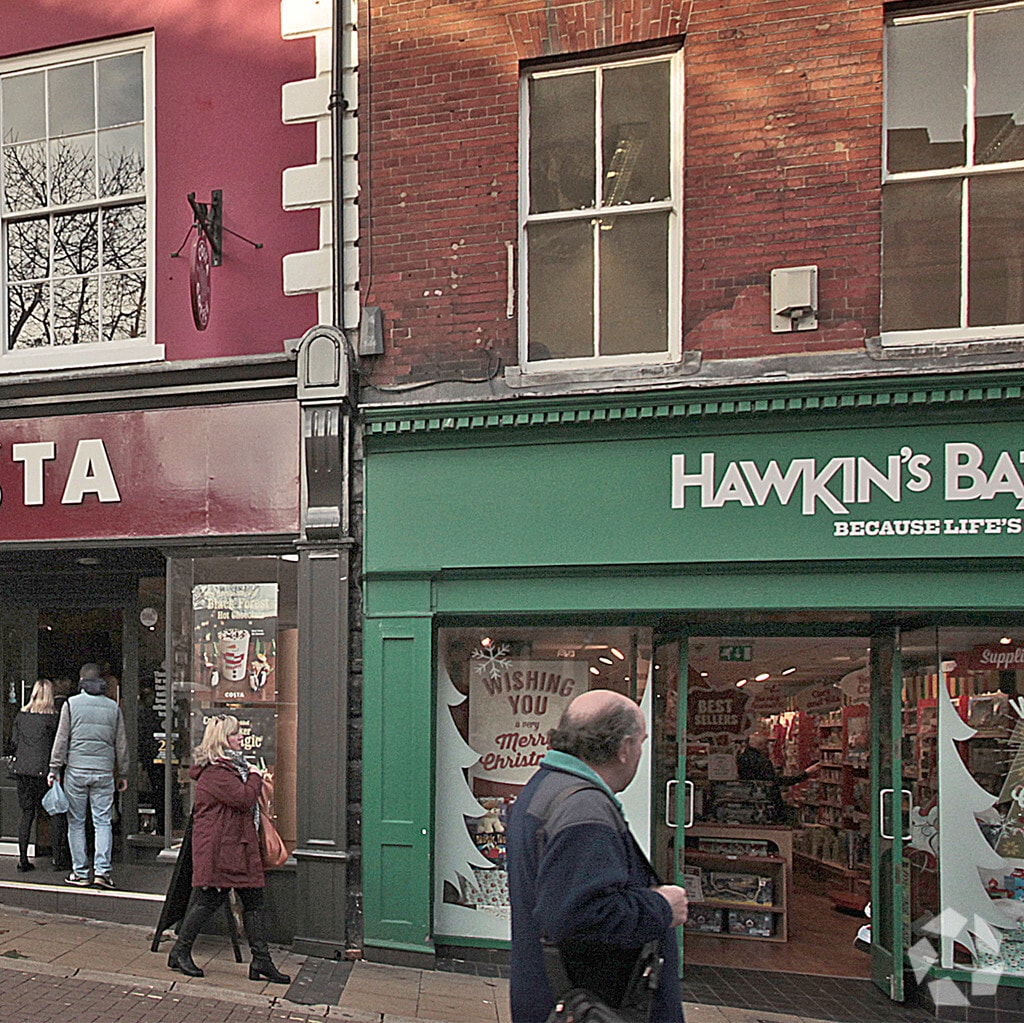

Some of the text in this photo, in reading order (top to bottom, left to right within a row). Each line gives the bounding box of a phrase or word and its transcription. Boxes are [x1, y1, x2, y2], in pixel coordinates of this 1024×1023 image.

[944, 442, 1024, 510] BA
[833, 518, 1023, 537] BECAUSE LIFE'S
[481, 669, 576, 697] WISHING
[508, 695, 548, 716] YOU
[697, 698, 733, 713] BEST
[522, 720, 540, 731] very
[694, 713, 739, 726] SELLERS
